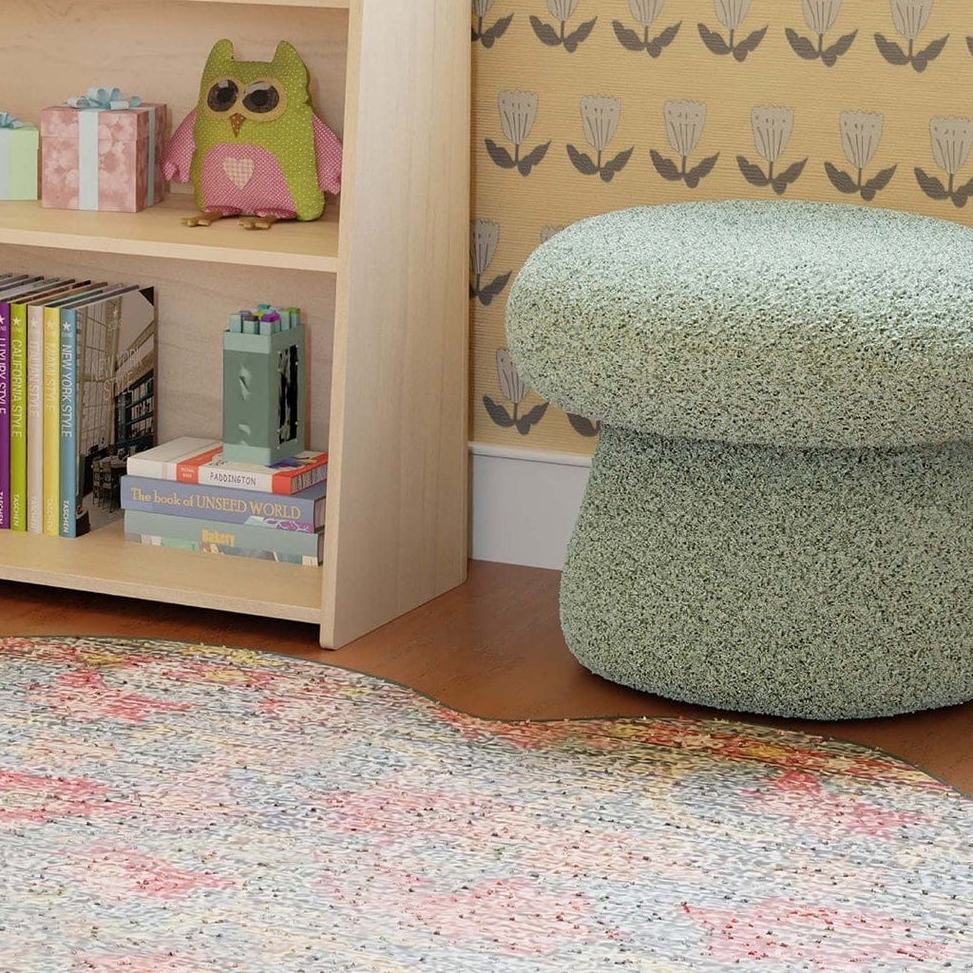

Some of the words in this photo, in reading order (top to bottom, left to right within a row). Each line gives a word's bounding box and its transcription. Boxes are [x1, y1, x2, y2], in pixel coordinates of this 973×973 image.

[11, 339, 23, 402] CALIFORNIA
[61, 344, 72, 369] NEW
[91, 357, 115, 382] NEW
[29, 384, 40, 419] STYLE
[45, 378, 56, 412] STYLE
[61, 372, 72, 402] YORK
[103, 371, 134, 402] STYLE
[11, 405, 23, 438] STYLE
[61, 404, 72, 438] STYLE
[209, 471, 257, 486] PADDINGTON
[131, 487, 152, 502] The
[154, 489, 181, 508] book
[182, 493, 195, 507] of
[249, 503, 301, 520] WORLD
[201, 528, 236, 548] Bakery
